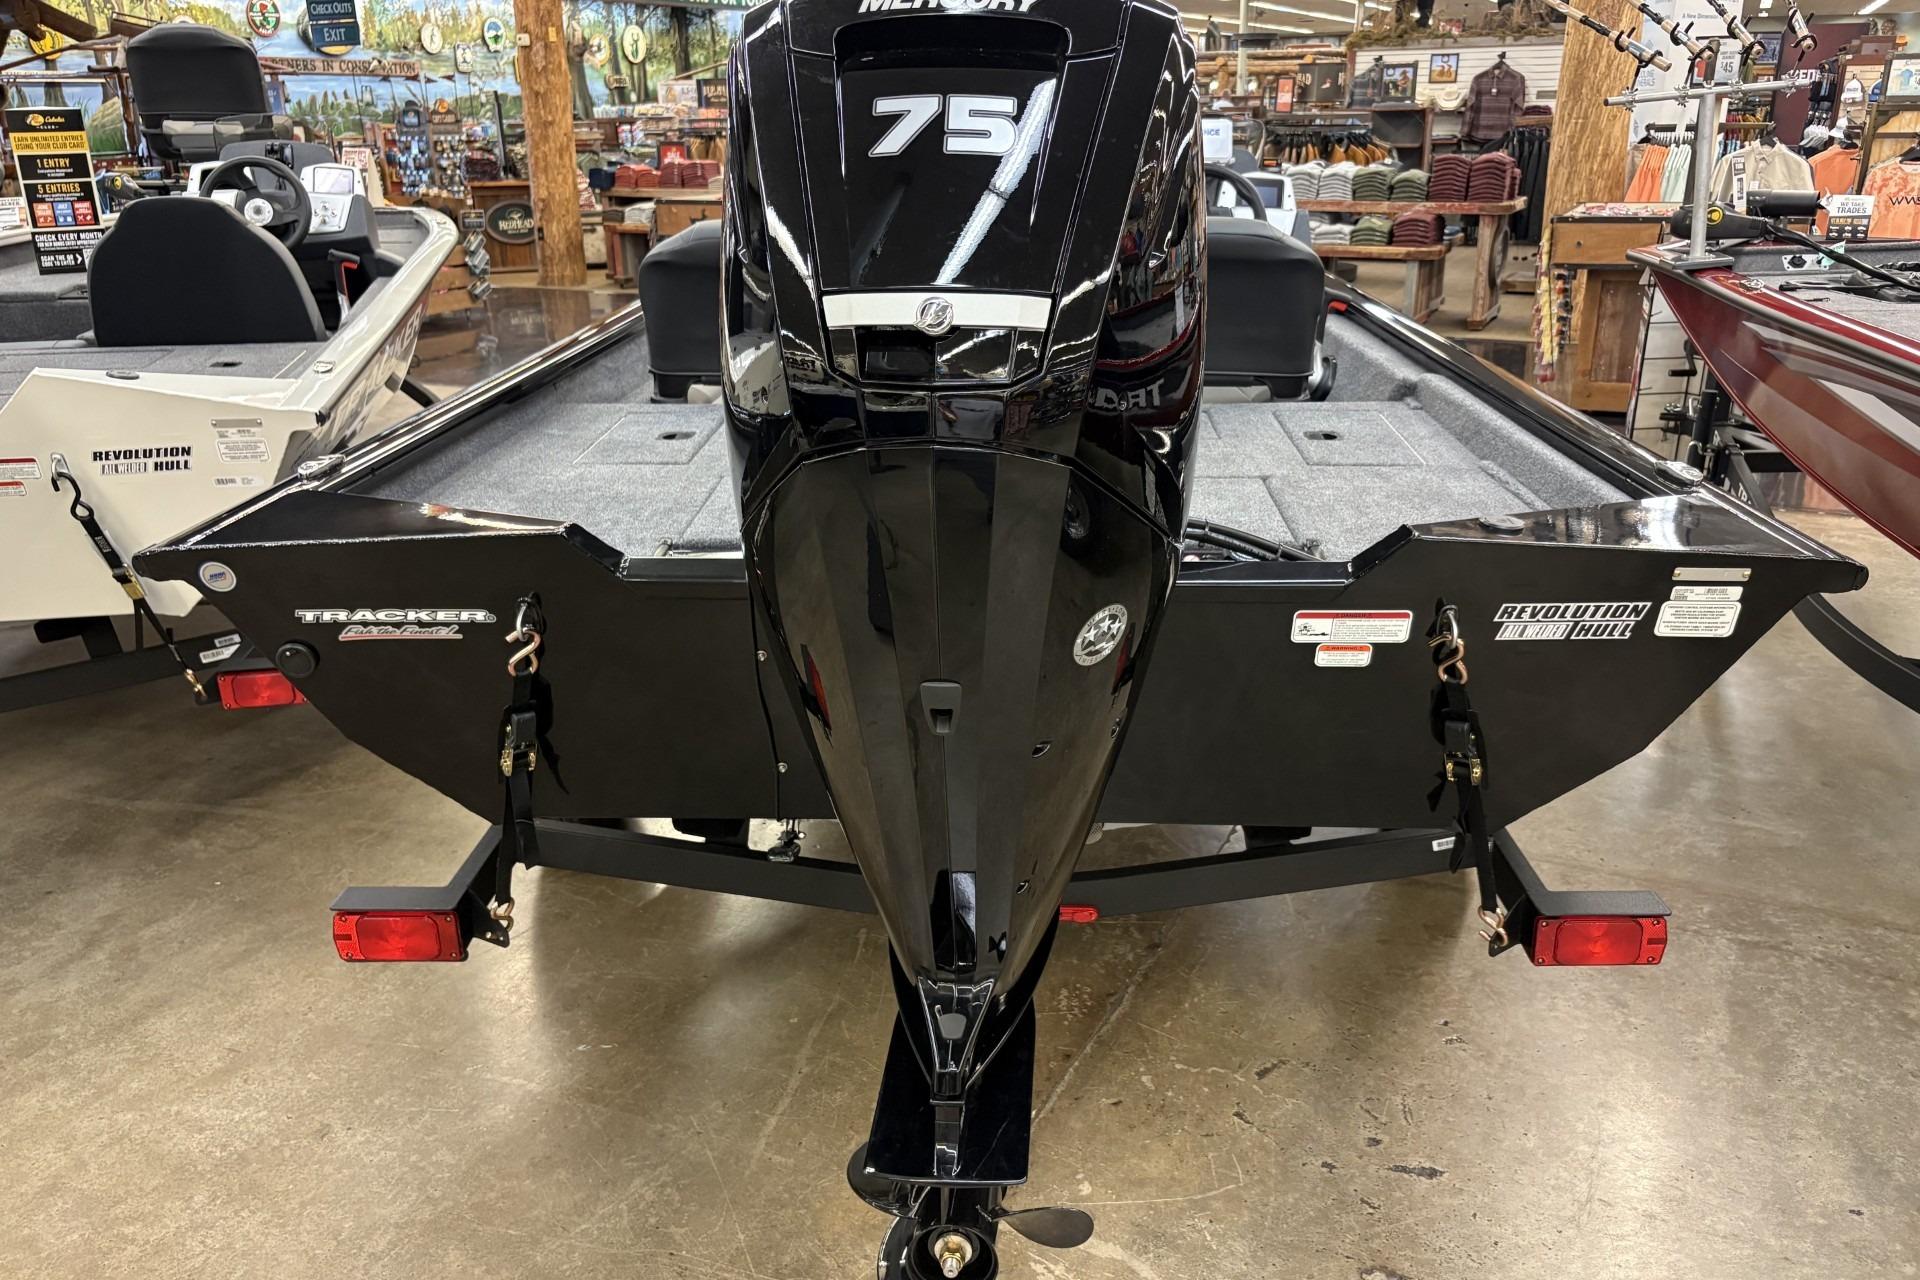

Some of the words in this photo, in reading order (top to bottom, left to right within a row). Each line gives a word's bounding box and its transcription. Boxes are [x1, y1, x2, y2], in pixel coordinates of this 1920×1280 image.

[311, 3, 333, 15] CHECK
[333, 2, 352, 13] OUTS
[323, 28, 346, 42] EXIT
[322, 62, 335, 71] IN
[868, 94, 1018, 157] 75
[37, 159, 41, 168] 1
[43, 158, 70, 168] ENTRY
[37, 184, 43, 194] 5
[45, 183, 81, 193] ENTRIES
[1836, 206, 1868, 214] TRADES
[35, 234, 57, 242] CHECK
[57, 232, 78, 241] EVERY
[92, 447, 191, 461] REVOLUTION
[154, 460, 190, 471] HULL
[295, 609, 488, 623] TRACKER
[1497, 602, 1649, 620] REVOLUTION
[1502, 624, 1523, 638] ALL
[1522, 624, 1567, 638] WELDED
[1573, 623, 1632, 638] HULL
